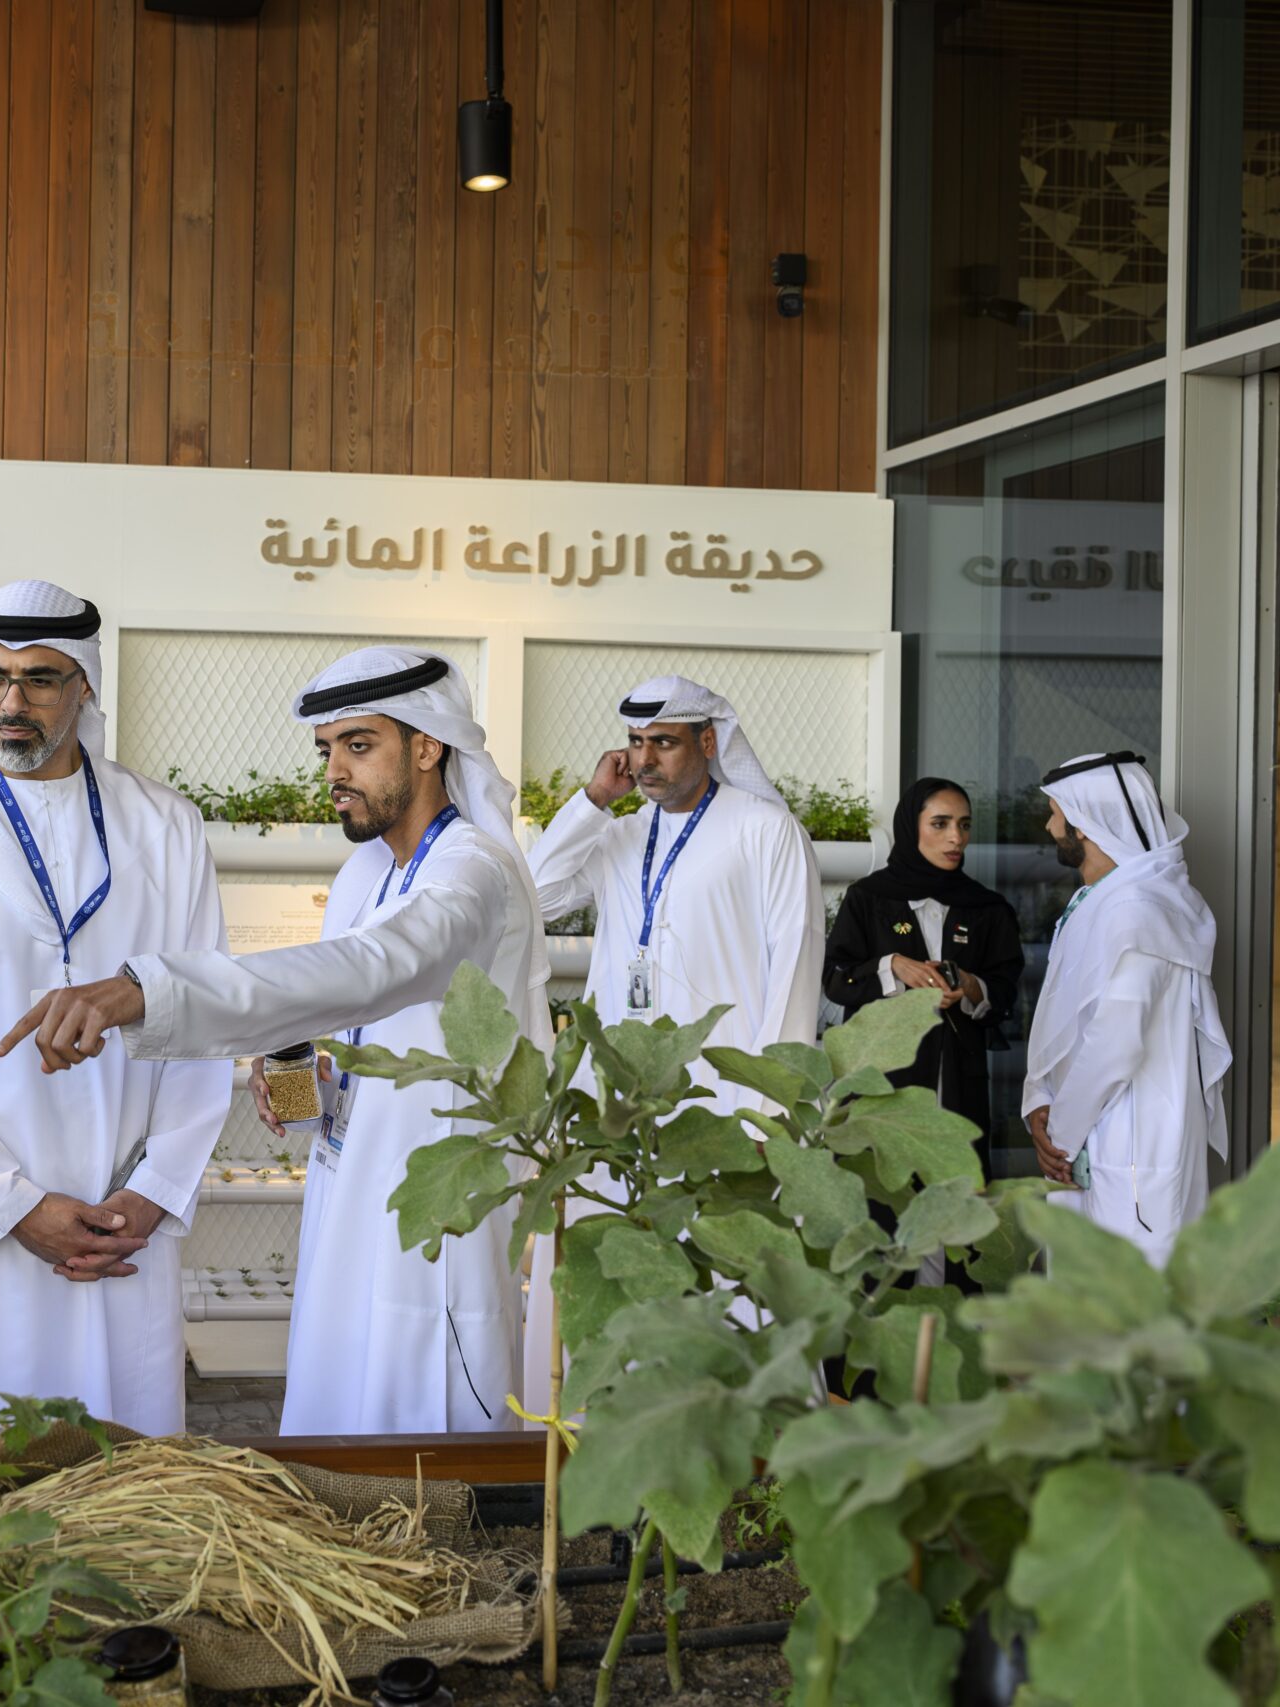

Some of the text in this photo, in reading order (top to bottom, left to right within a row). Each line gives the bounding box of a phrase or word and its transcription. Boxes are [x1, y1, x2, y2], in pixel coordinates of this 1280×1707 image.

[259, 517, 824, 594] حديقة الزراعة المائية
